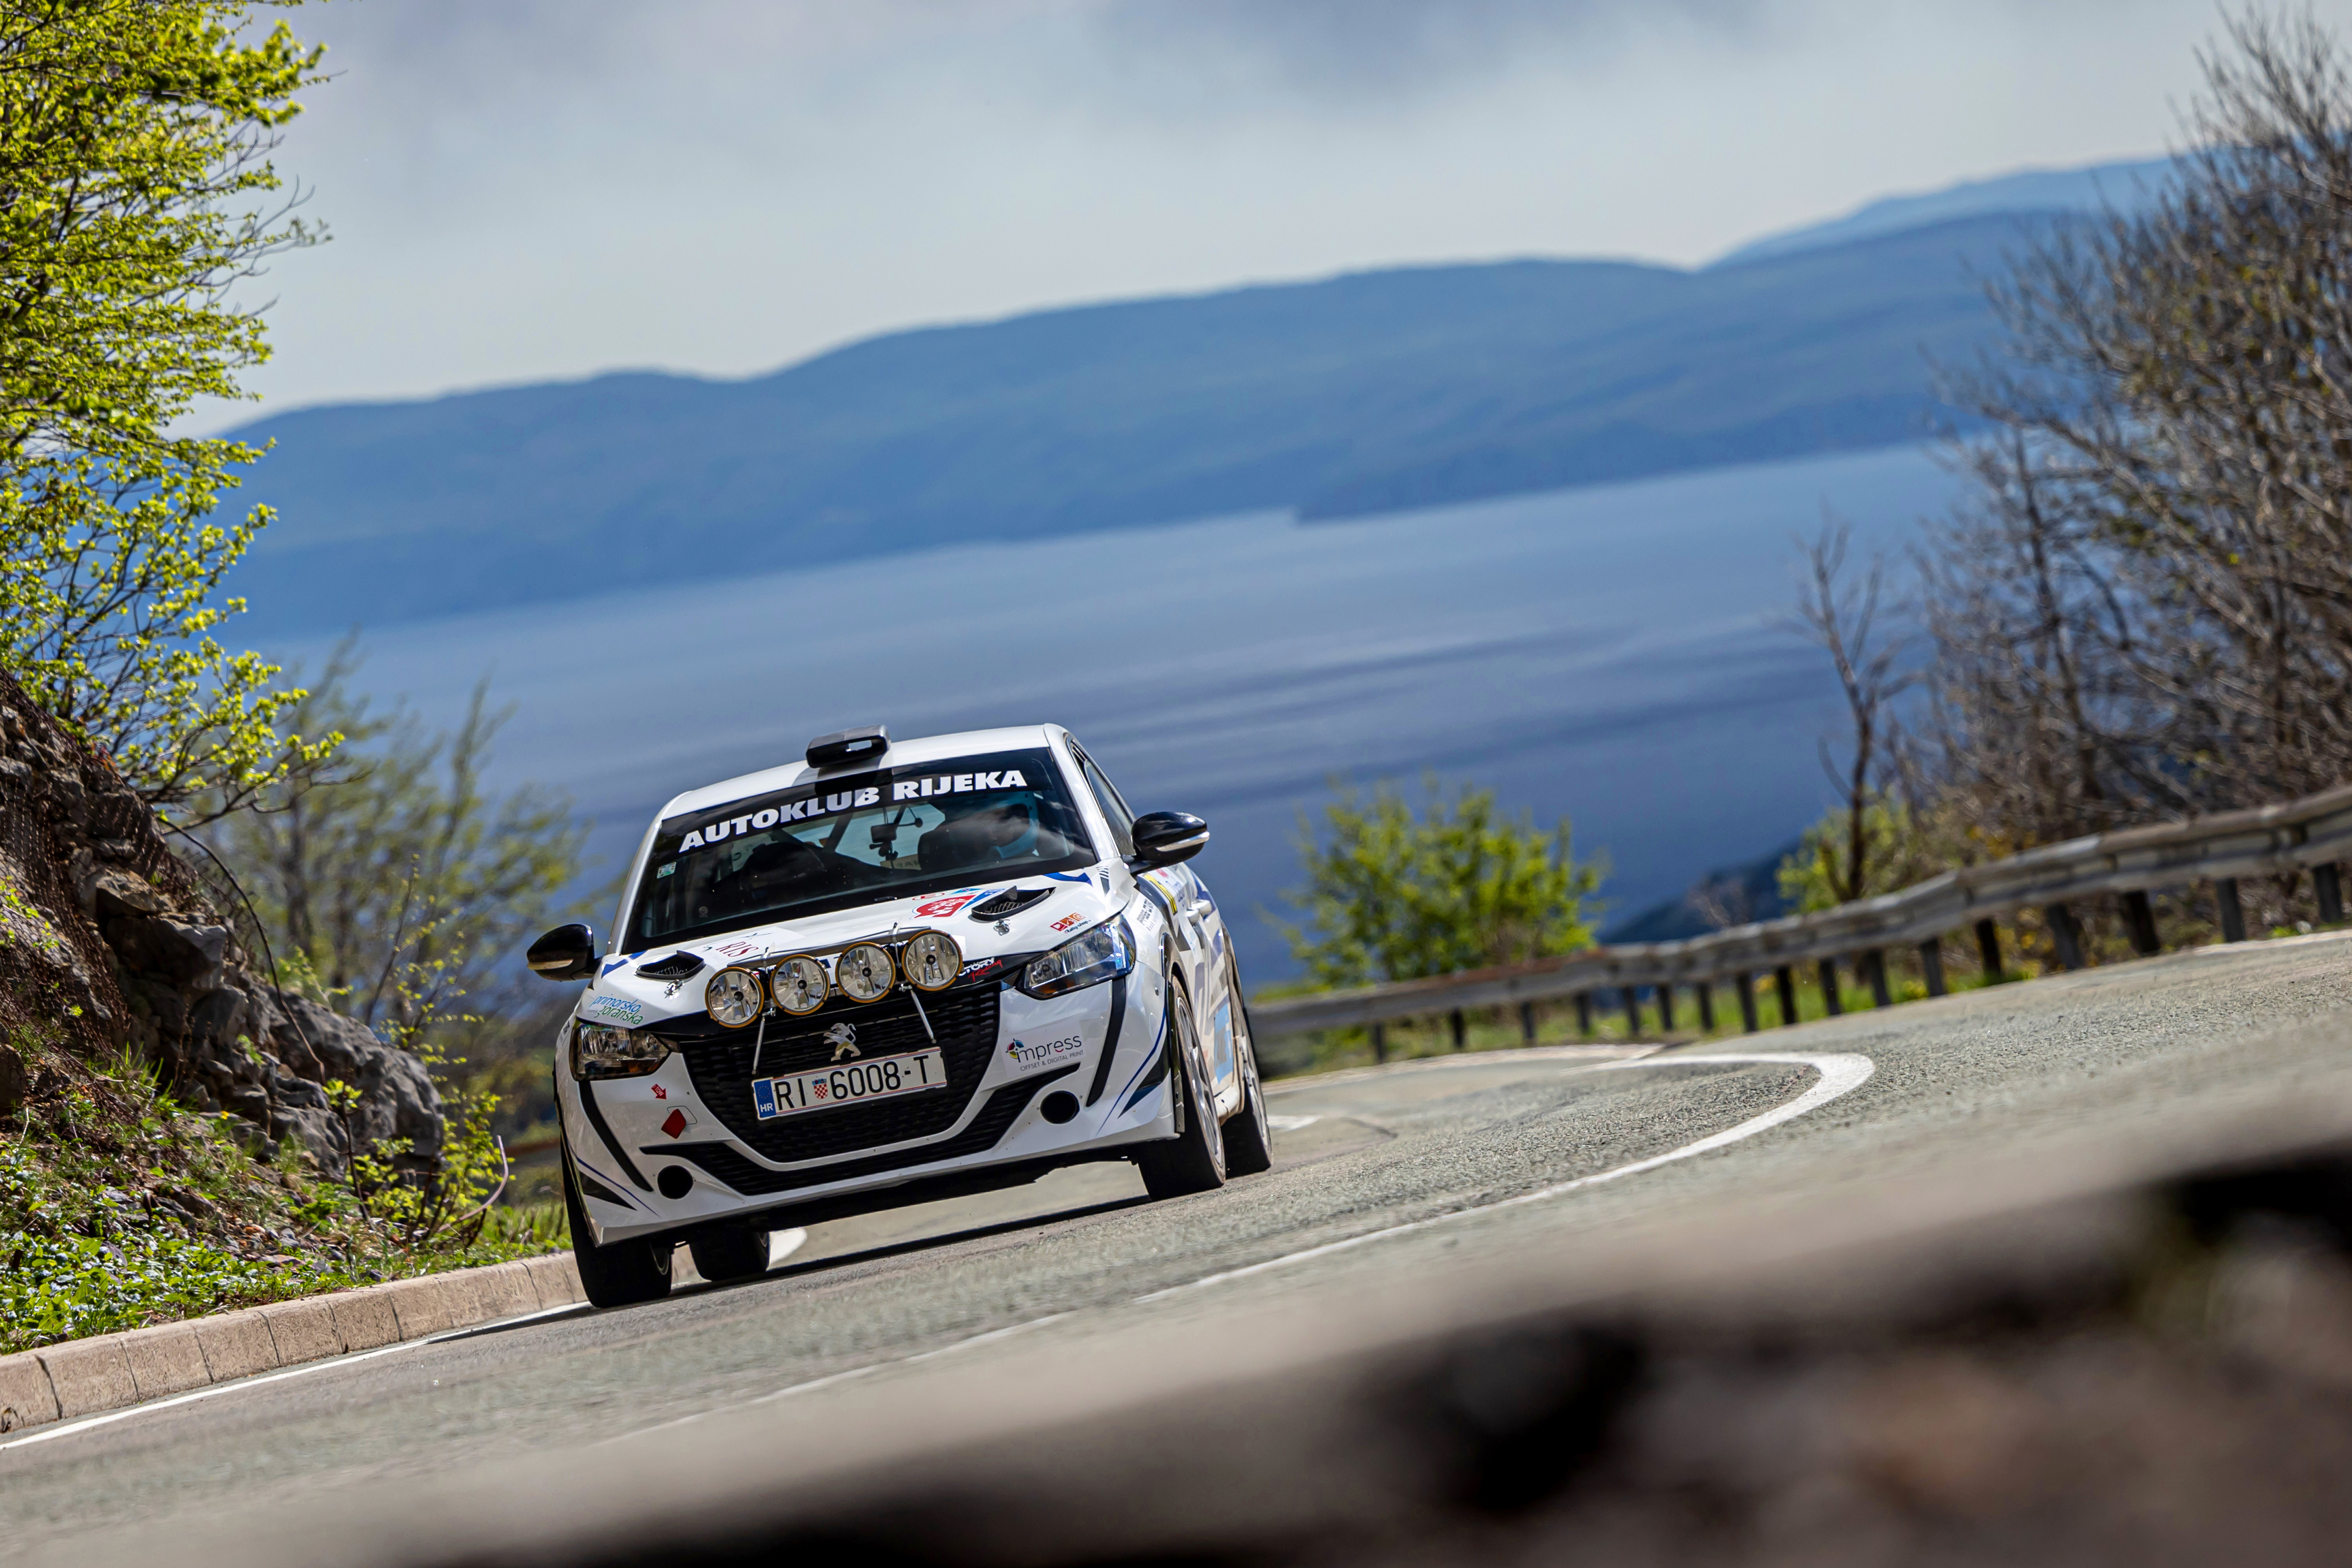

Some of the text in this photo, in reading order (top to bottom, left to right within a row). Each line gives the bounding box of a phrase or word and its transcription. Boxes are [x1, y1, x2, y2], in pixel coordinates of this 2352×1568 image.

[679, 770, 1027, 853] AUTOKLUB RIJEKA
[589, 994, 642, 1013] primorsko
[1020, 1062, 1040, 1071] OFFSET
[1047, 1055, 1068, 1064] DIGITAL
[1069, 1050, 1083, 1058] PRINT
[655, 1086, 664, 1096] TOW
[775, 1055, 929, 1111] RI 6008-T
[760, 1103, 773, 1112] HR
